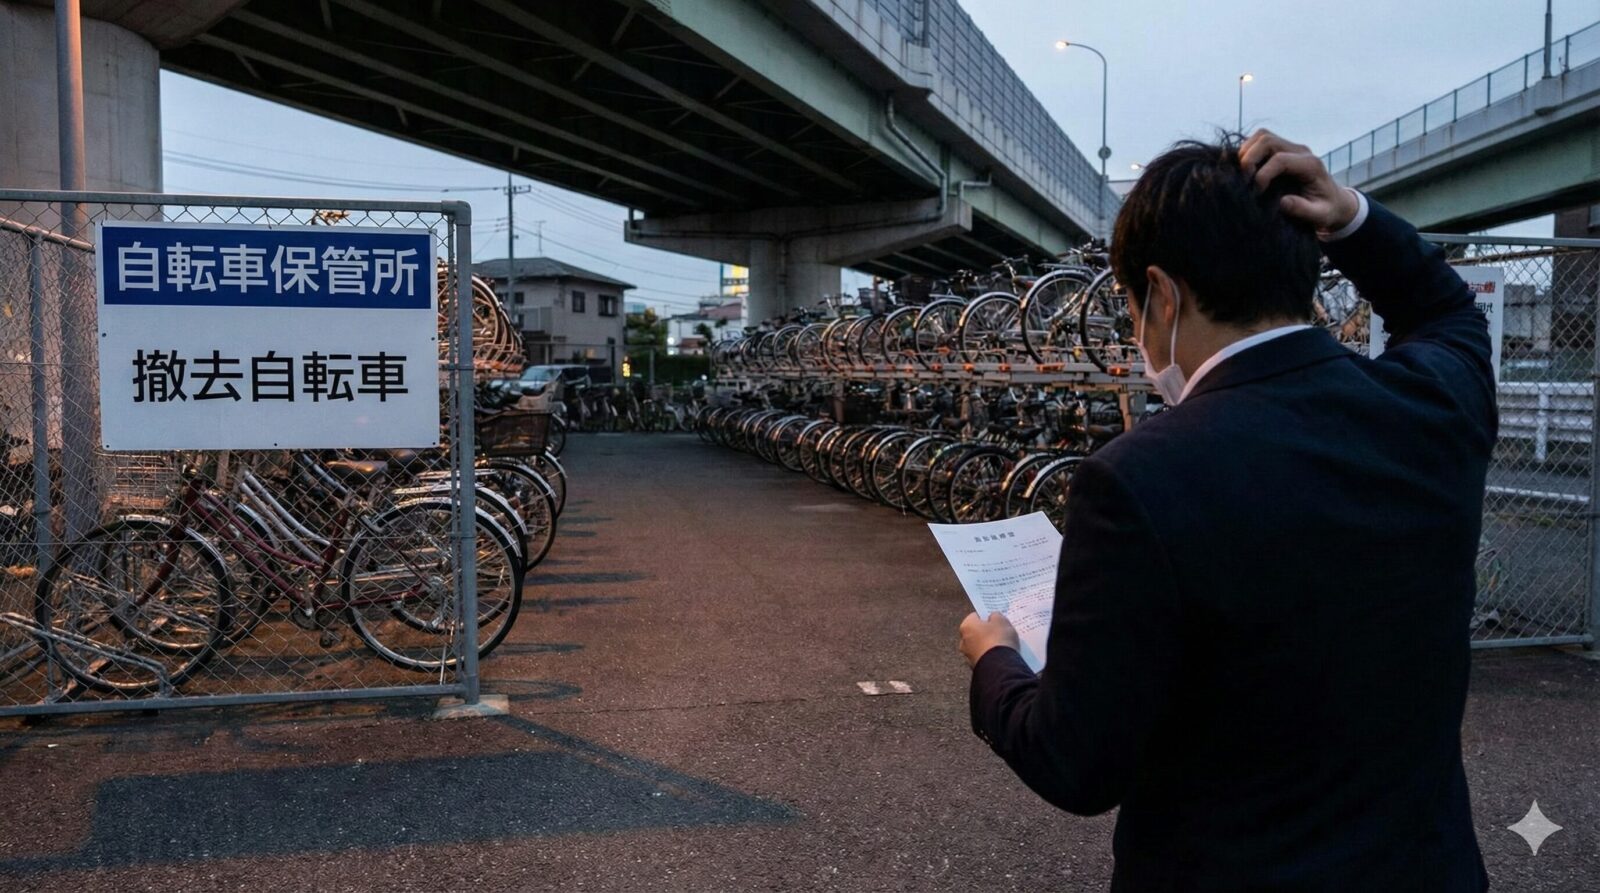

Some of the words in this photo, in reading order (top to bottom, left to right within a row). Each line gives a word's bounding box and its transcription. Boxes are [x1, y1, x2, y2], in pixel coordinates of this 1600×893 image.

[117, 241, 420, 297] 自転車保管所
[132, 349, 409, 403] 撤去自転車
